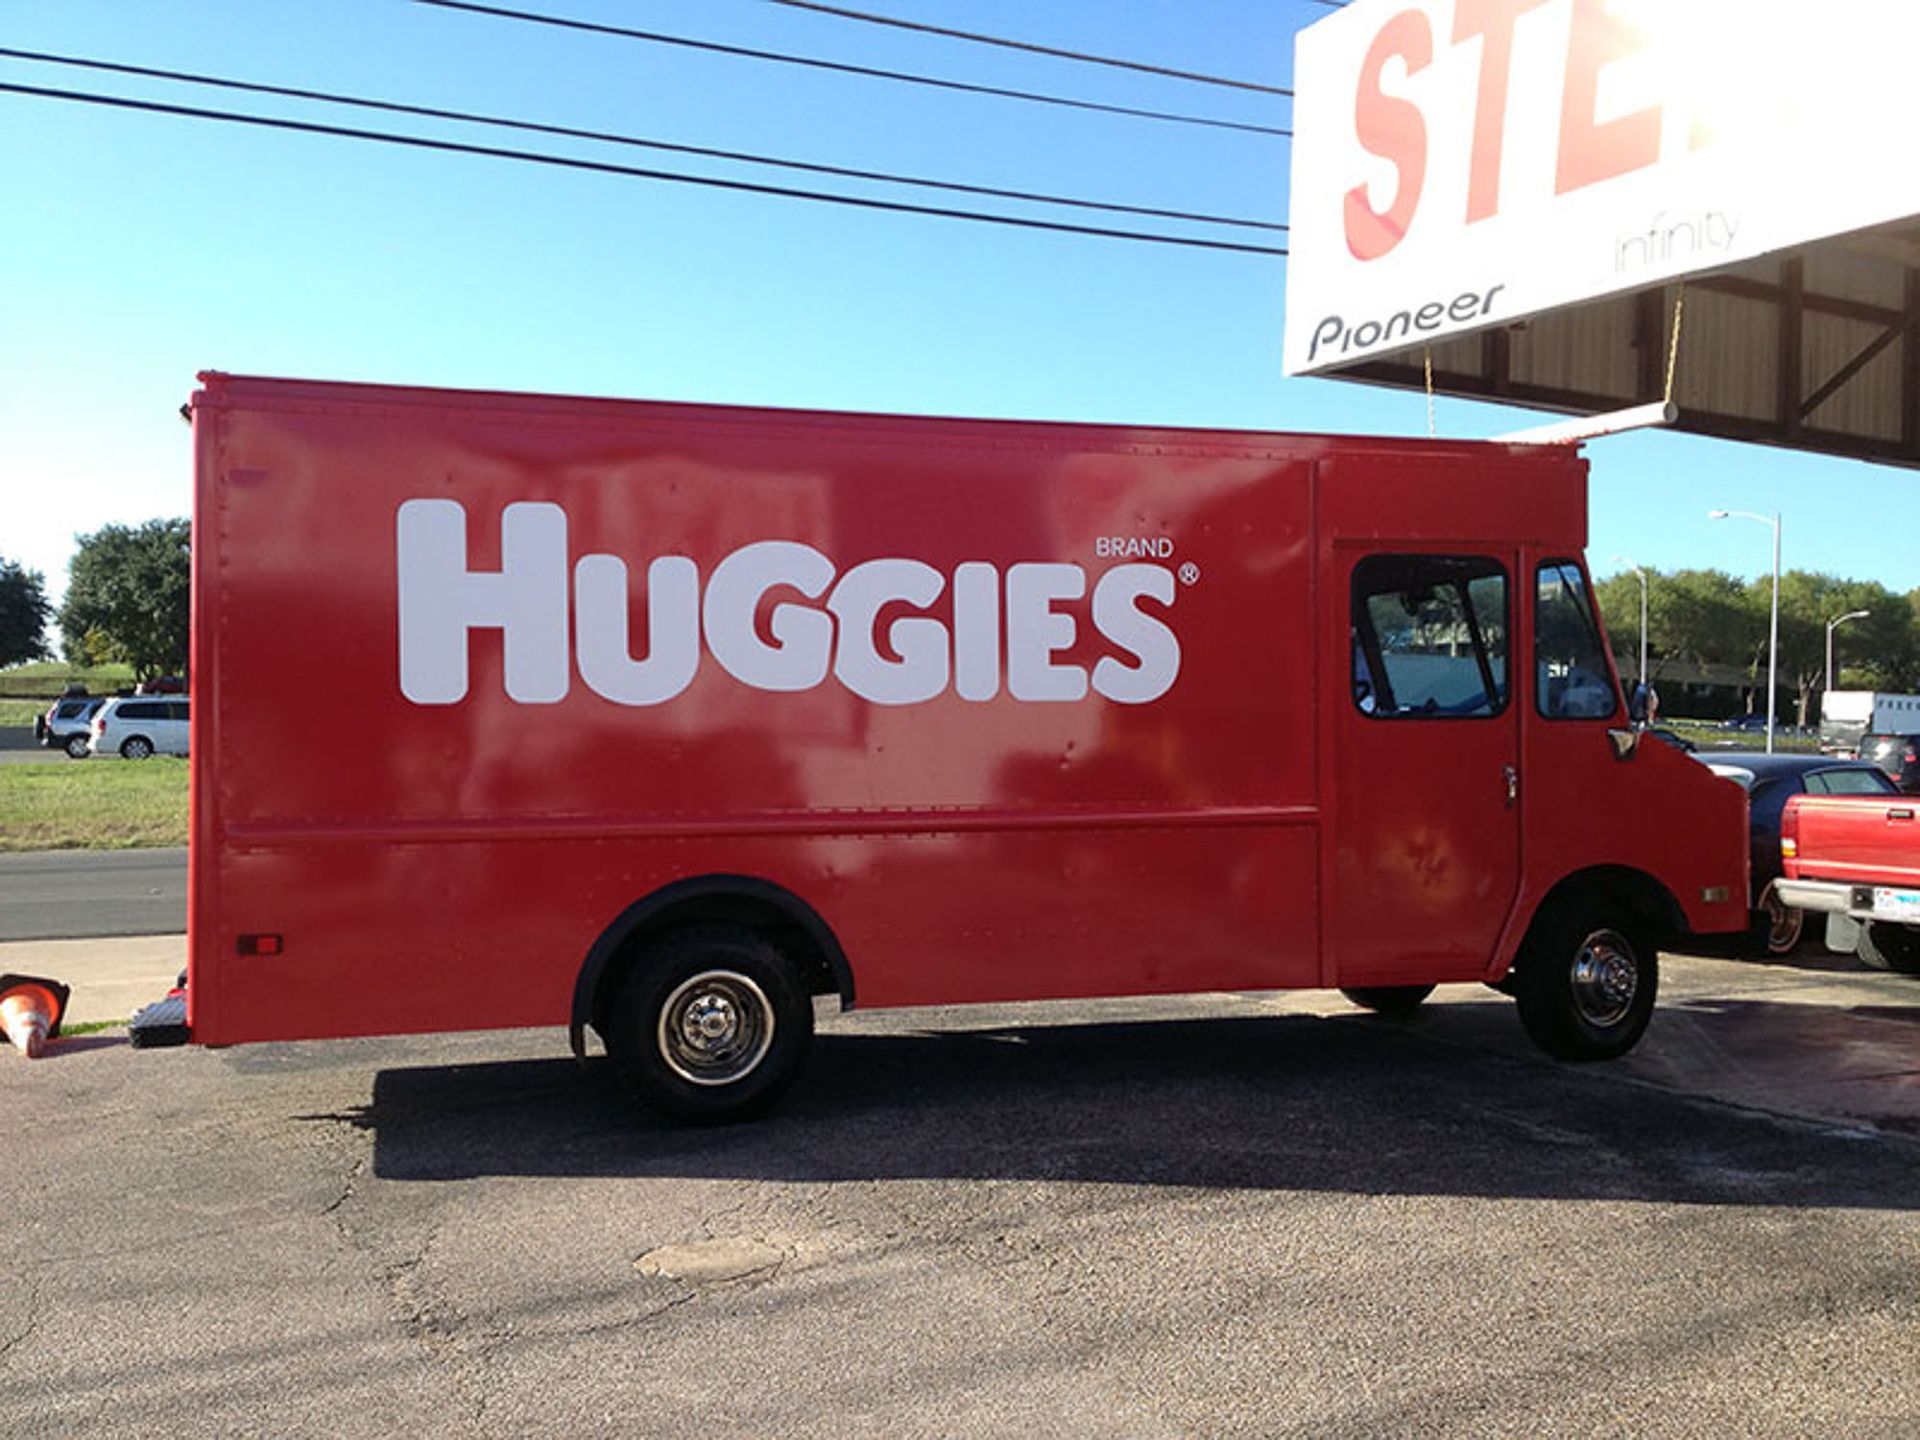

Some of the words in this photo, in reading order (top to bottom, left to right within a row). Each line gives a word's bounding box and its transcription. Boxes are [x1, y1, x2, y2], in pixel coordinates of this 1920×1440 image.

[1308, 284, 1505, 362] Pioneer
[1095, 536, 1174, 559] BRAND
[397, 498, 1181, 707] HUGGIES
